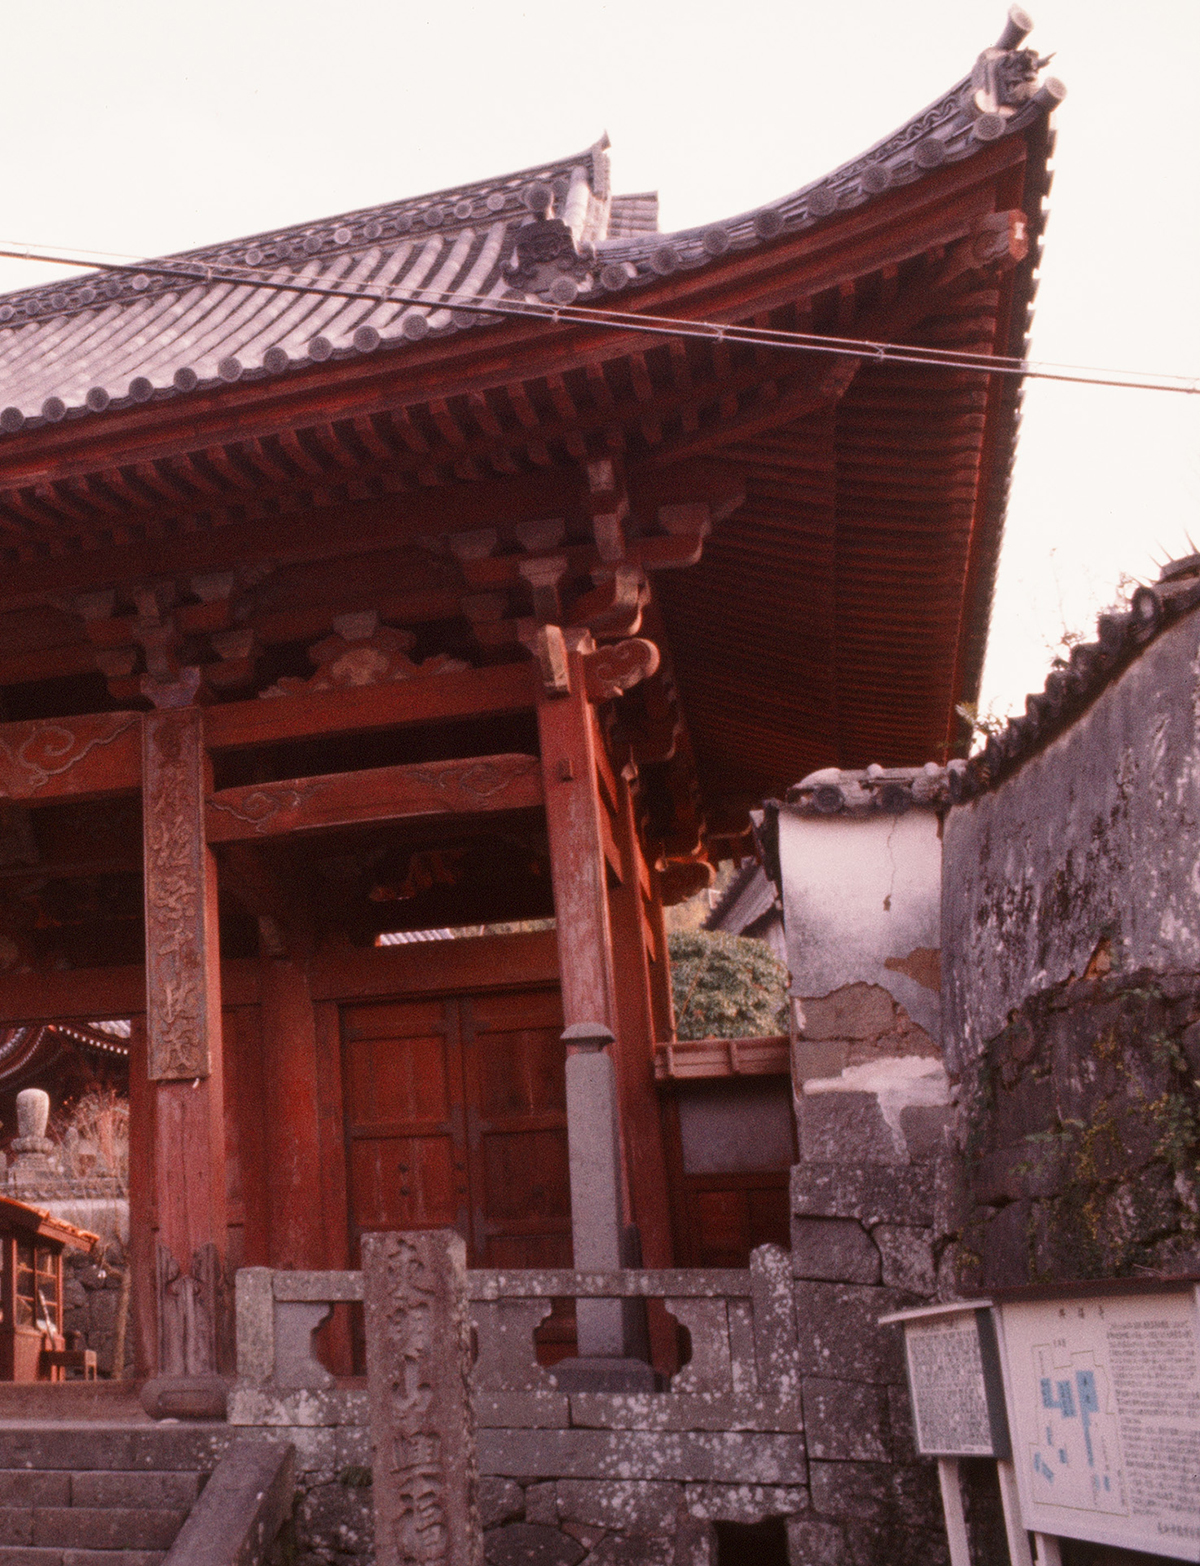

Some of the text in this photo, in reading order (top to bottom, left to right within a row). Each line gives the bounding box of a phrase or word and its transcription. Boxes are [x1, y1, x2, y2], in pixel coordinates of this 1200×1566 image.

[387, 1237, 450, 1566] 東明山興福
